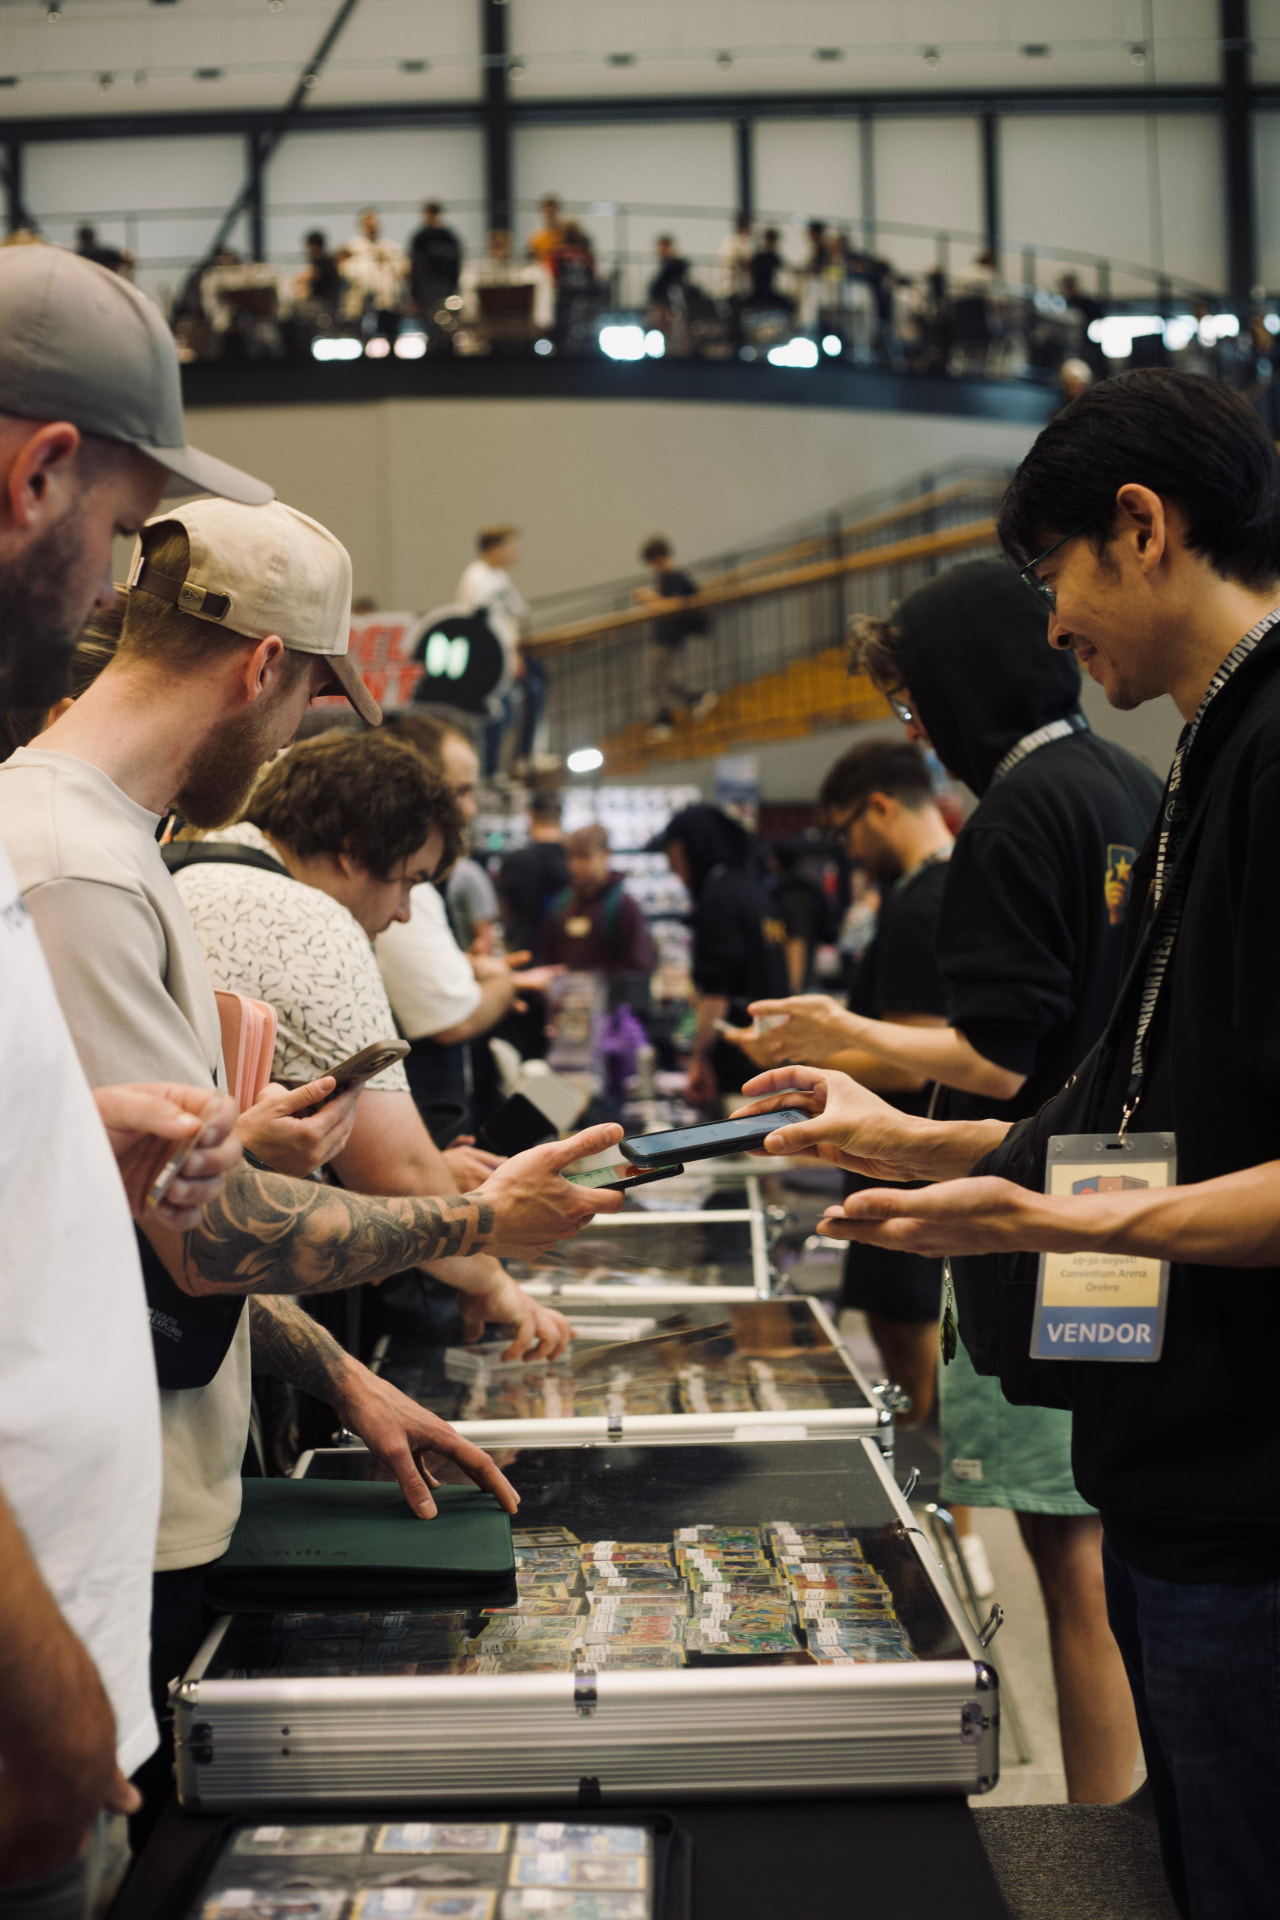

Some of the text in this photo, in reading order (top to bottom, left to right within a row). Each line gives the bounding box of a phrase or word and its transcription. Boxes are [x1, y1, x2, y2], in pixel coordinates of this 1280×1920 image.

[1060, 1268, 1147, 1278] Conventum Arena
[1086, 1281, 1120, 1292] Örebro
[1046, 1322, 1152, 1344] VENDOR
